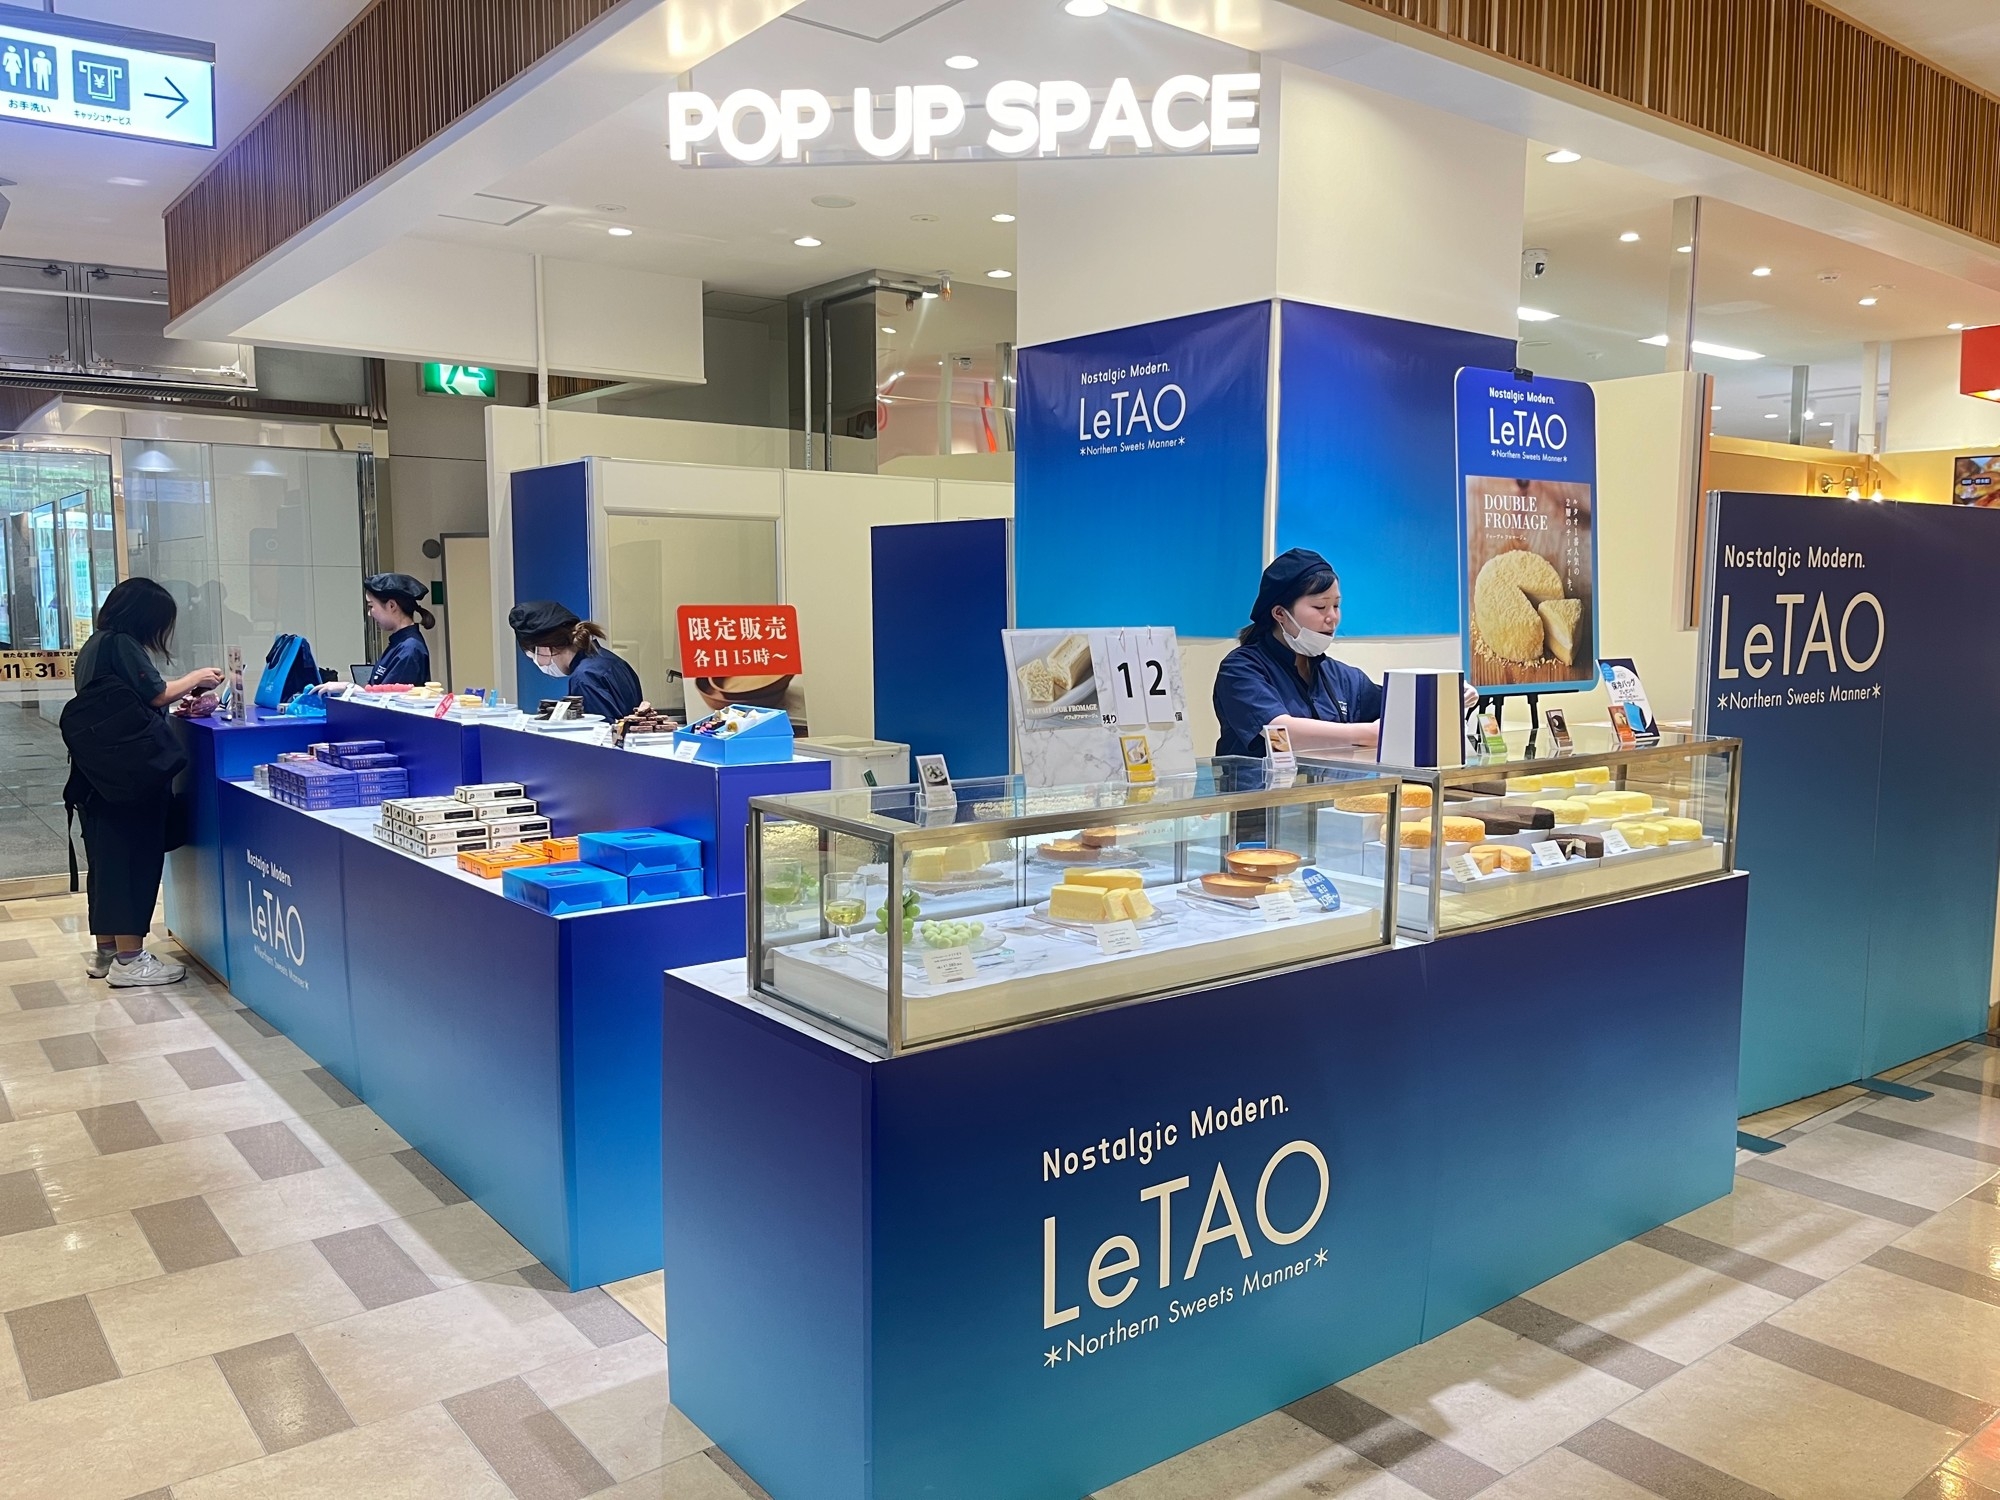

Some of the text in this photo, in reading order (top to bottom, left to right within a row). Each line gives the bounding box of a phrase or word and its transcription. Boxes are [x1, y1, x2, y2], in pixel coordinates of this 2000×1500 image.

[8, 99, 52, 113] お手洗い
[73, 109, 132, 126] キャッシュサービス
[668, 73, 1261, 163] POP UP SPACE
[1081, 361, 1170, 385] Nostalgic Modern.
[1489, 386, 1555, 405] Nostalgic Modern.
[1080, 384, 1186, 441] LeTAO
[1489, 407, 1567, 450] LeTAO
[1120, 441, 1145, 453] Sweets
[1522, 451, 1541, 461] Sweets
[1484, 493, 1537, 513] DOUBLE
[1484, 512, 1548, 531] FROMAGE
[1724, 544, 1866, 577] Nostalgic Modern.
[687, 616, 787, 641] 限定販売
[1718, 590, 1885, 679] LeTAO
[1068, 703, 1098, 713] FROMAGE
[1787, 687, 1825, 706] Sweets
[1102, 713, 1117, 725] 残り
[246, 848, 292, 888] Nostalgic Modern.
[248, 880, 305, 967] LeTAO
[1043, 1093, 1289, 1182] Nostalgic Modern.
[1043, 1139, 1330, 1330] LeTAO
[1168, 1285, 1234, 1324] Sweets
